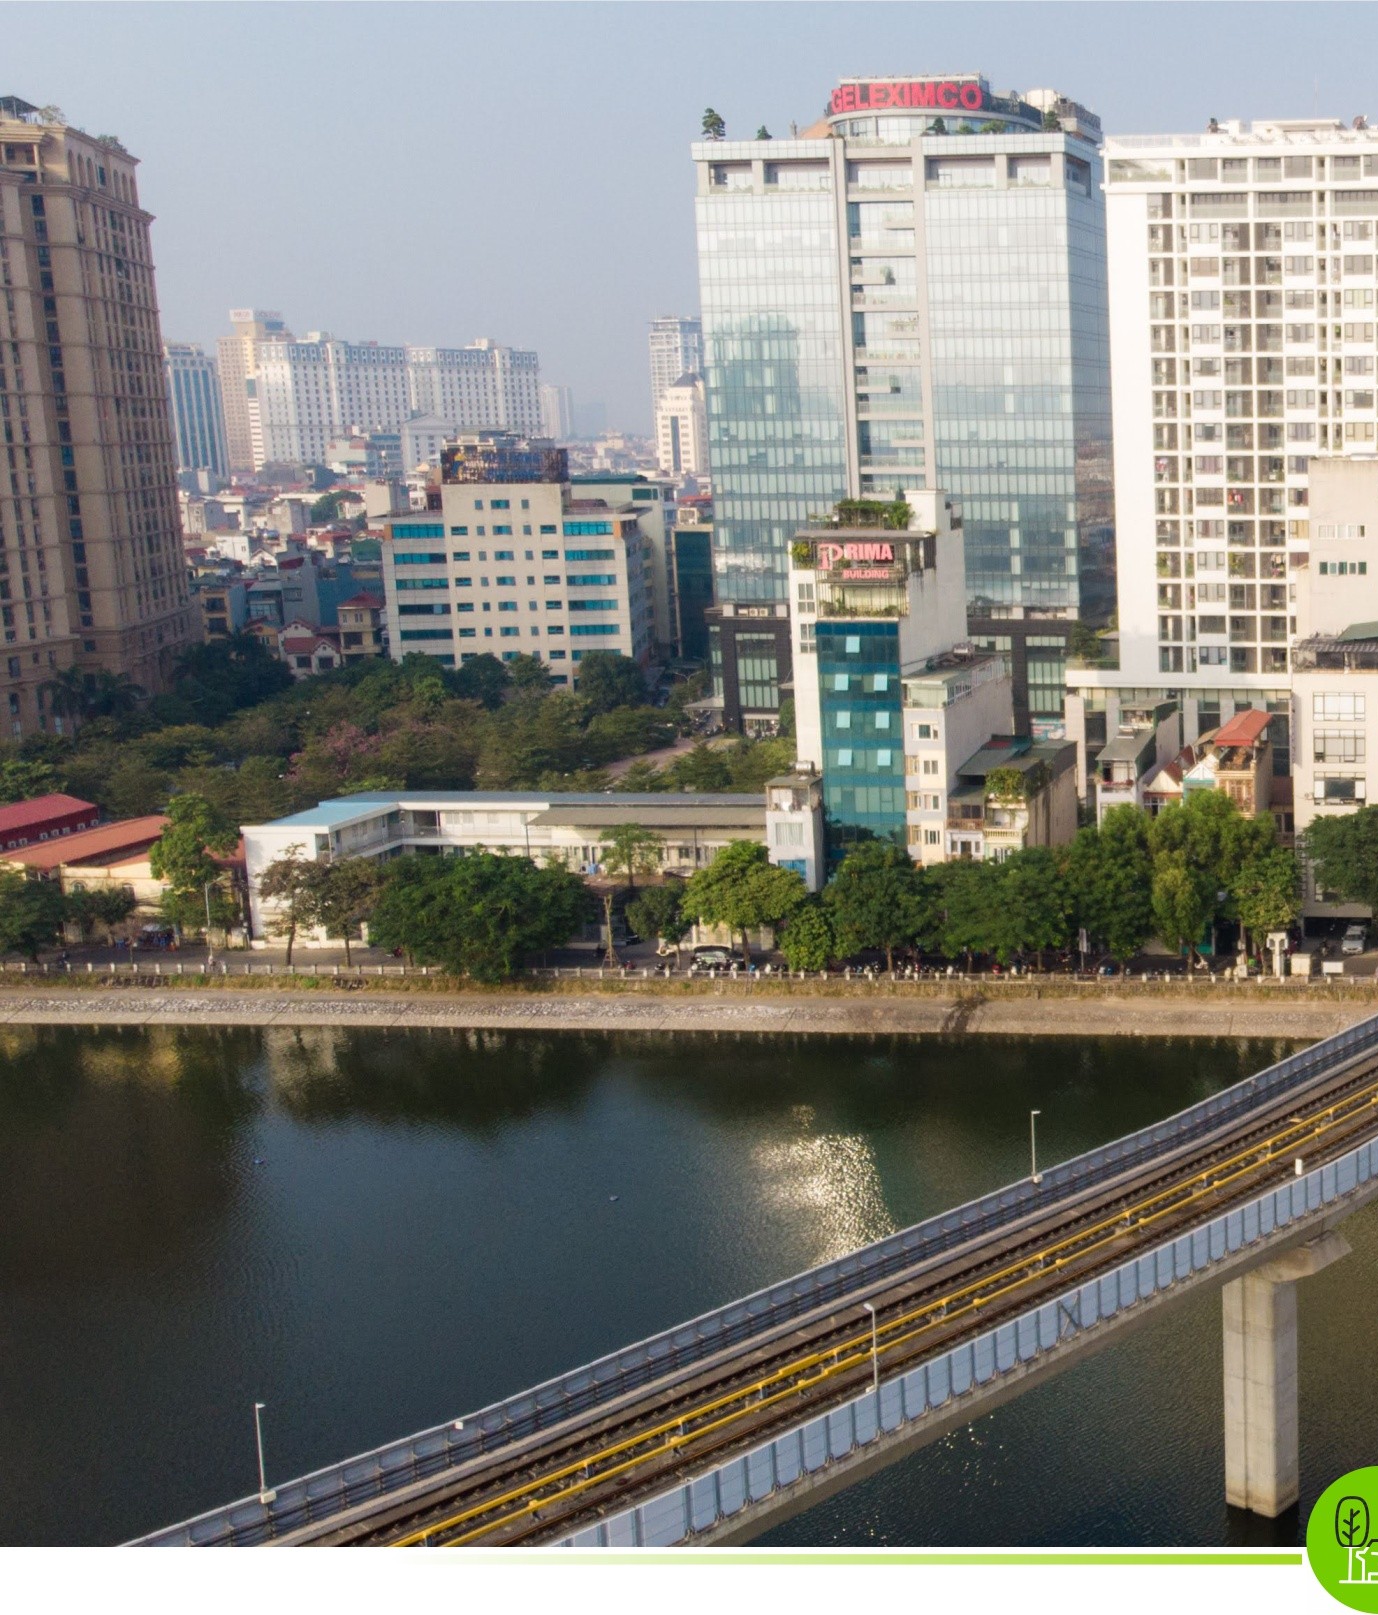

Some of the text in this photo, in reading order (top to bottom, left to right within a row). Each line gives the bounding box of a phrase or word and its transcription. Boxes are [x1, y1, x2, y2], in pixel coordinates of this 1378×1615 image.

[831, 82, 983, 114] GELEXIMCO
[817, 542, 893, 570] PRIMA
[842, 569, 889, 579] BUILDING
